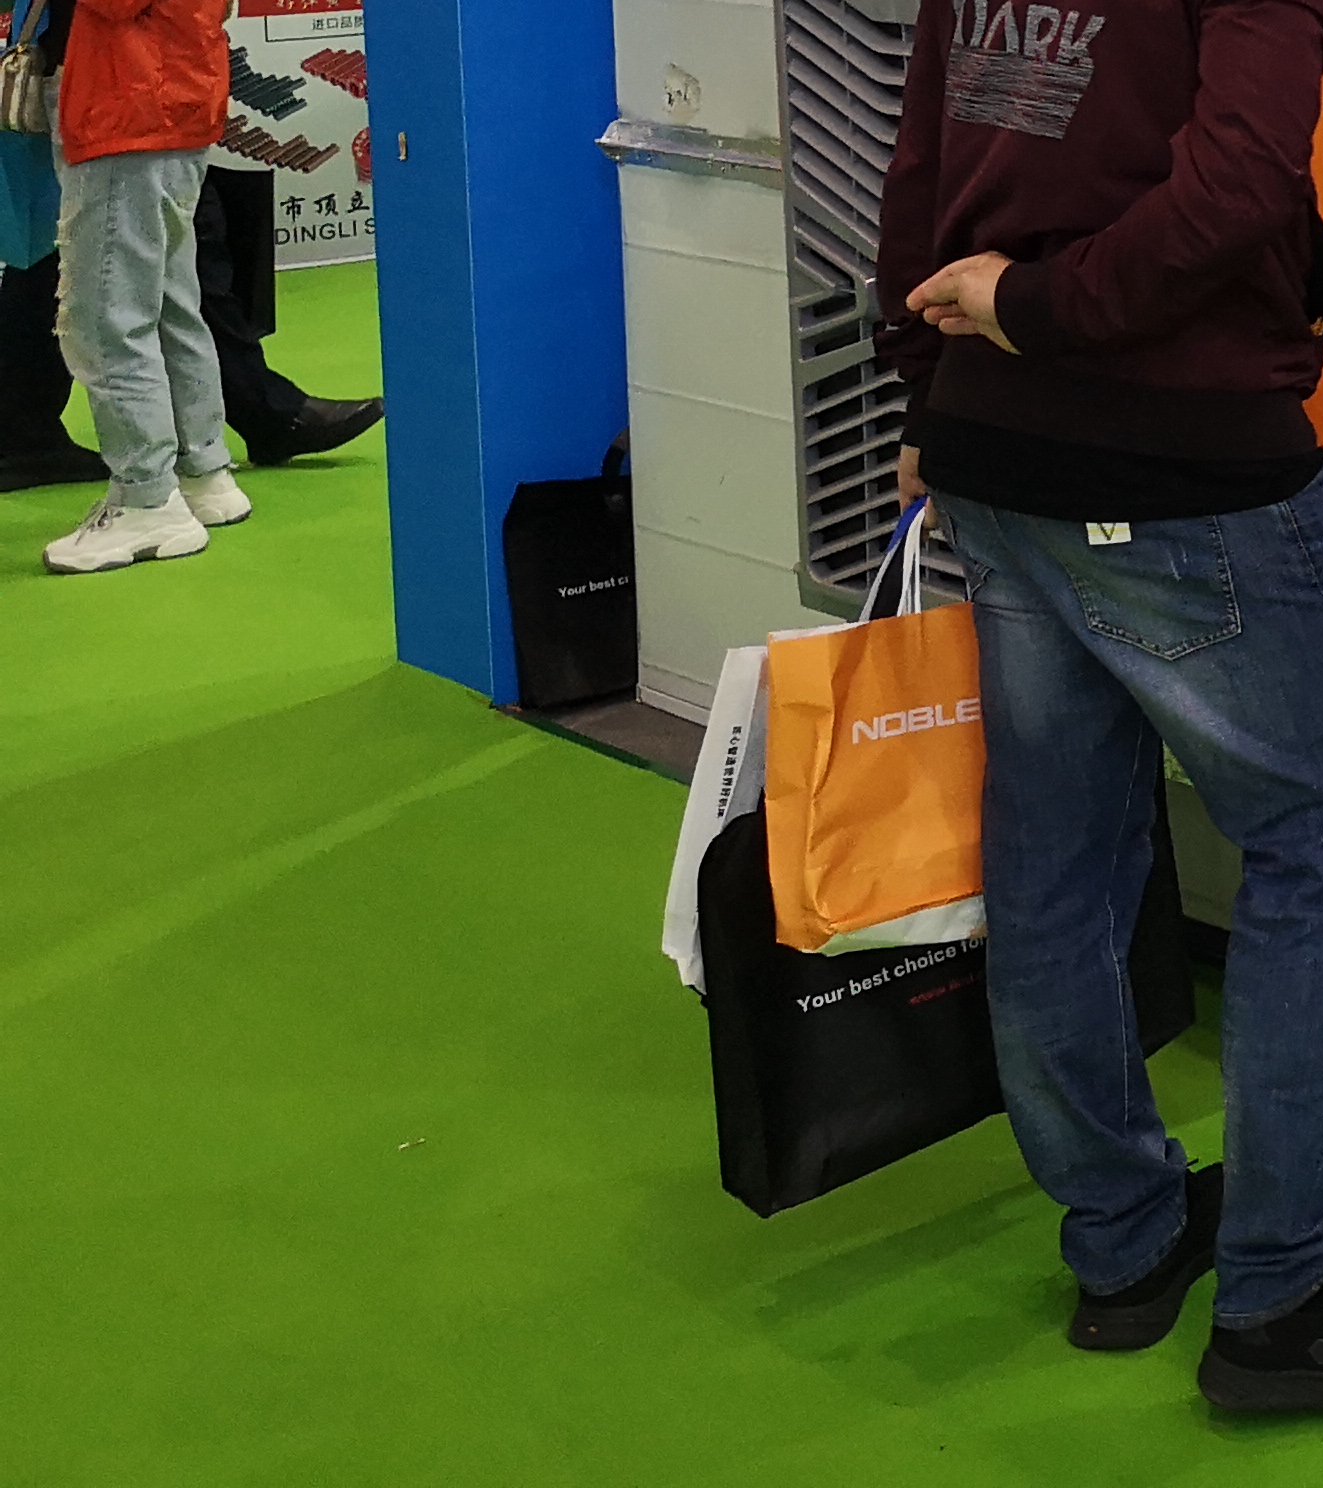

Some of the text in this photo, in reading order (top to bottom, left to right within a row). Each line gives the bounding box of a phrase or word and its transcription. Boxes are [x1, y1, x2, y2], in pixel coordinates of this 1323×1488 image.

[274, 220, 357, 245] DINGLI
[558, 586, 587, 598] Your
[589, 576, 616, 592] best
[852, 697, 980, 745] NOBLE
[797, 986, 847, 1013] Your
[848, 966, 891, 997] best
[893, 943, 957, 979] choice
